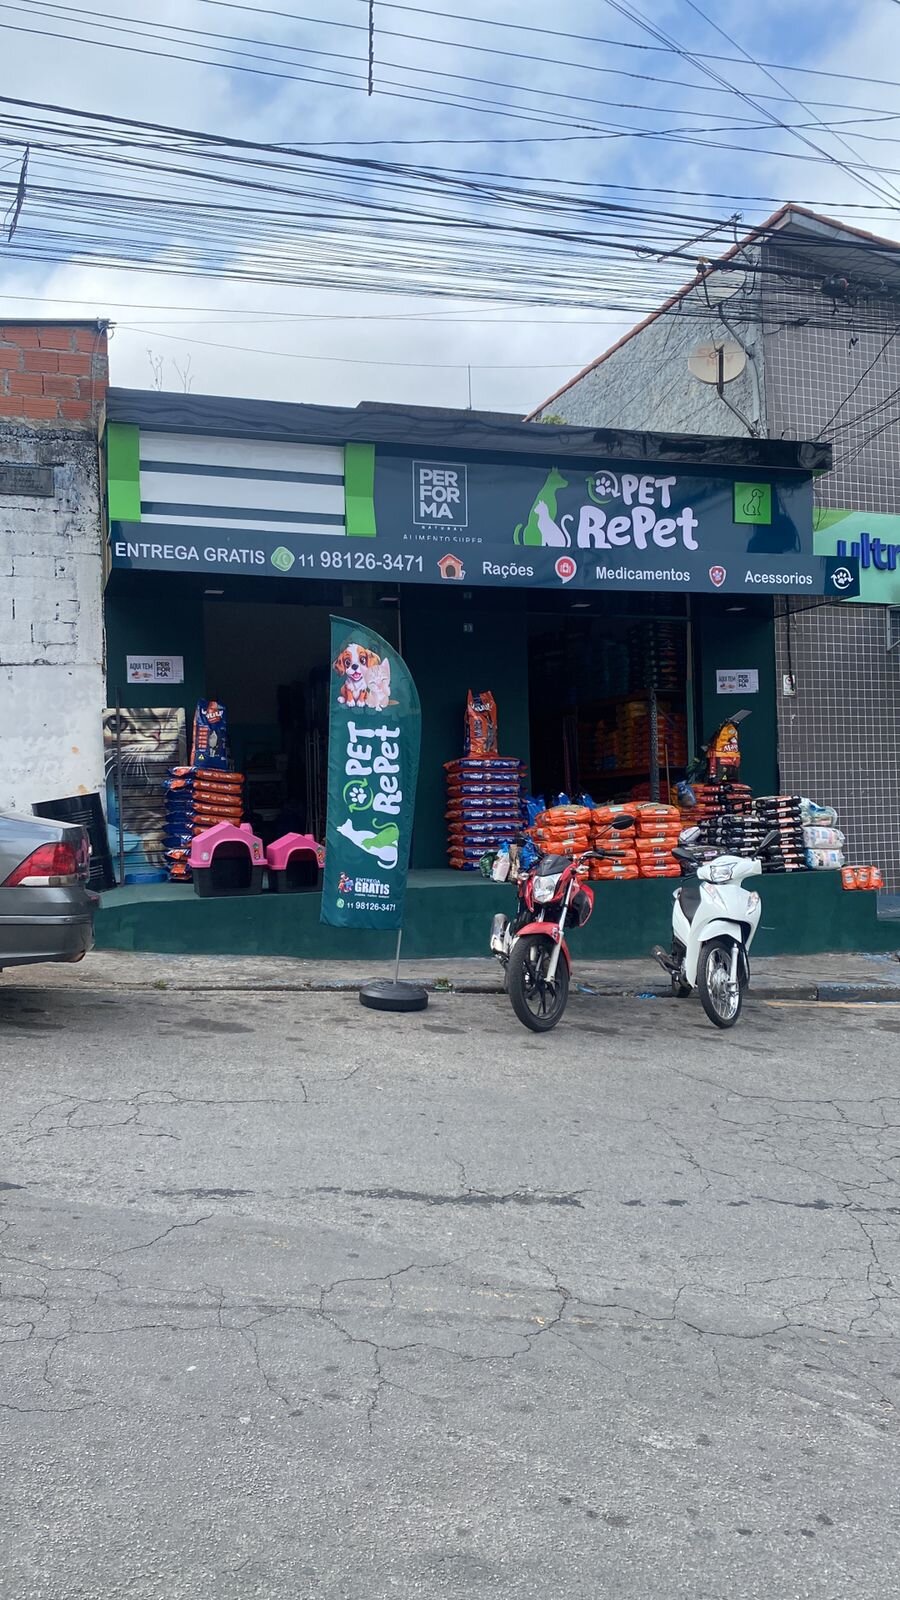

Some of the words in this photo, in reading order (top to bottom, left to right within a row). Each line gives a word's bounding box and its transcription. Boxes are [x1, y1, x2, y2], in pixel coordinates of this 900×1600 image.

[420, 468, 458, 487] PER
[420, 485, 460, 503] FOR
[621, 474, 677, 508] PET
[420, 501, 453, 519] MA
[577, 505, 698, 550] RePet
[115, 542, 200, 561] ENTREGA
[203, 547, 265, 564] GRATIS
[298, 553, 314, 568] 11
[319, 550, 424, 572] 98126-3471
[482, 561, 534, 579] Rações
[596, 566, 691, 582] Medicamentos
[744, 570, 813, 585] Acessorios
[345, 721, 375, 775] PET
[372, 725, 402, 815] RePet
[354, 881, 390, 895] GRATIS
[355, 901, 396, 912] 98126-3471
